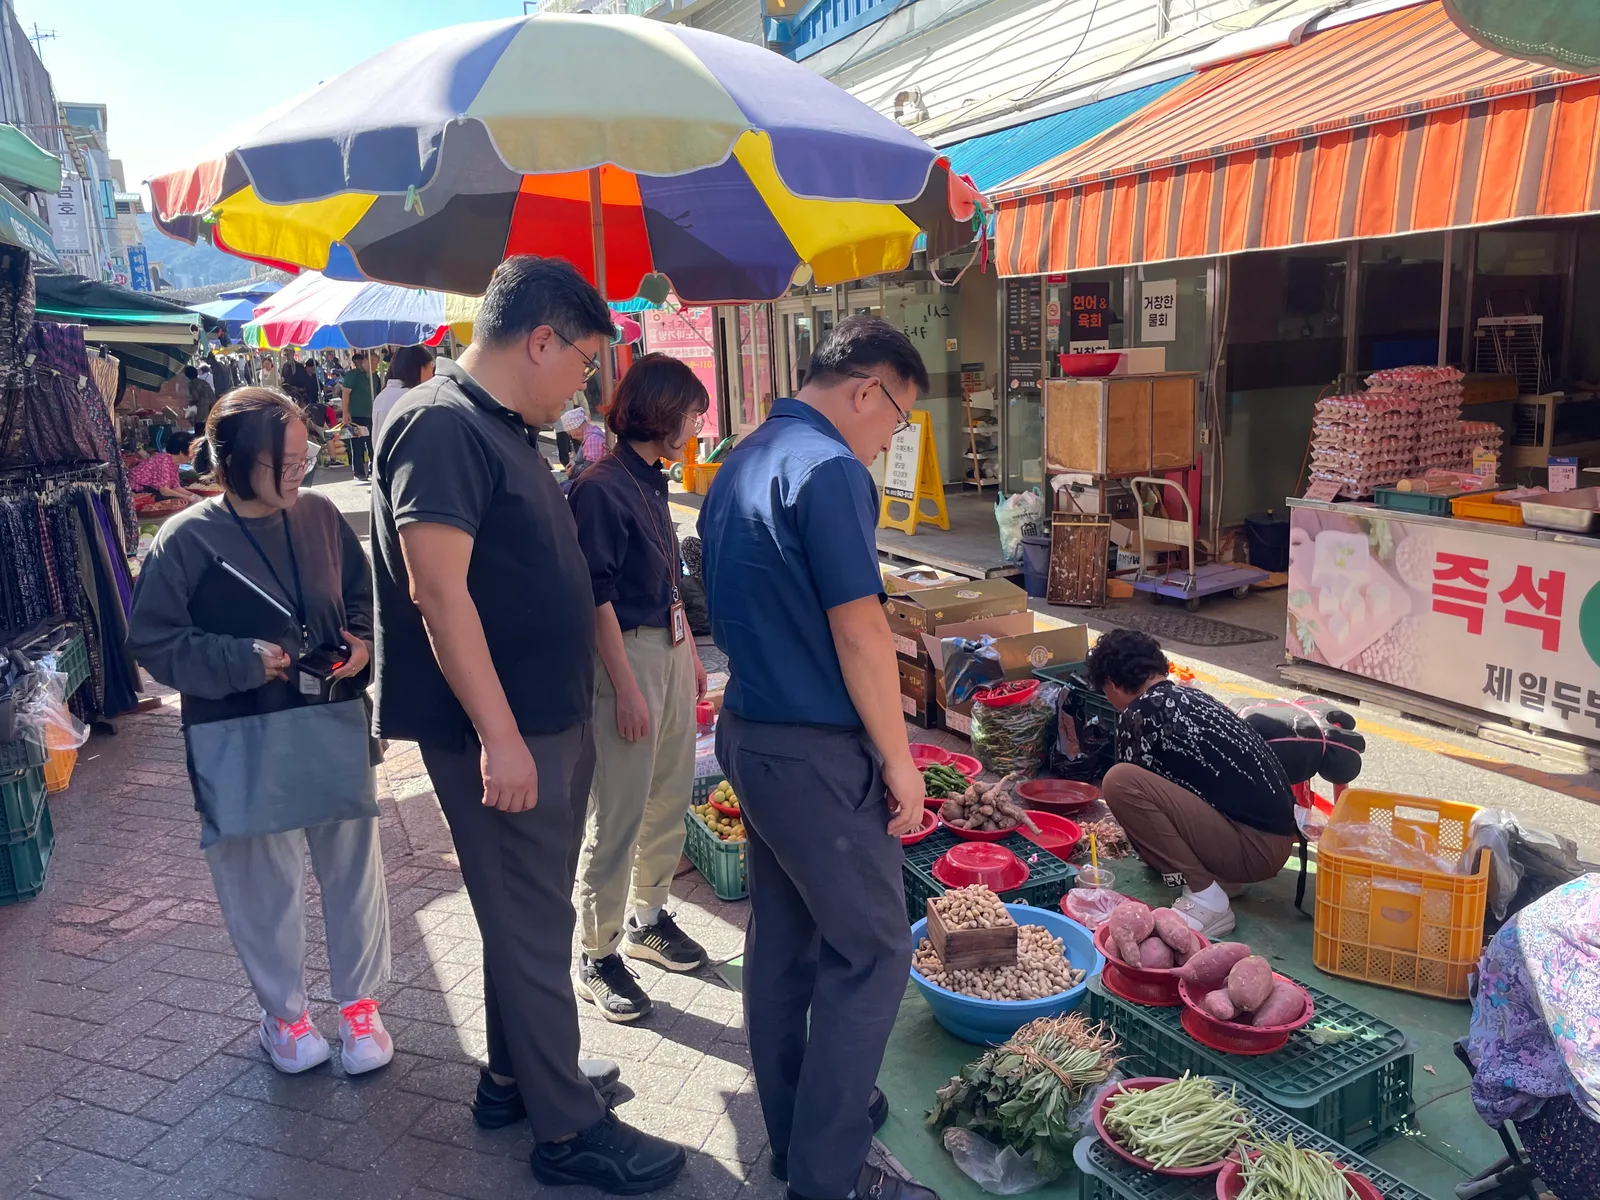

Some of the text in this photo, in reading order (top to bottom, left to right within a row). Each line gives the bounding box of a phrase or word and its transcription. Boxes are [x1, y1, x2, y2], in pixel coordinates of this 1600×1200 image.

[1073, 295, 1107, 310] 연어 &
[1144, 295, 1174, 310] 거창한
[1078, 313, 1102, 328] 육회
[1148, 313, 1168, 327] 물회
[1432, 551, 1566, 652] 즉석
